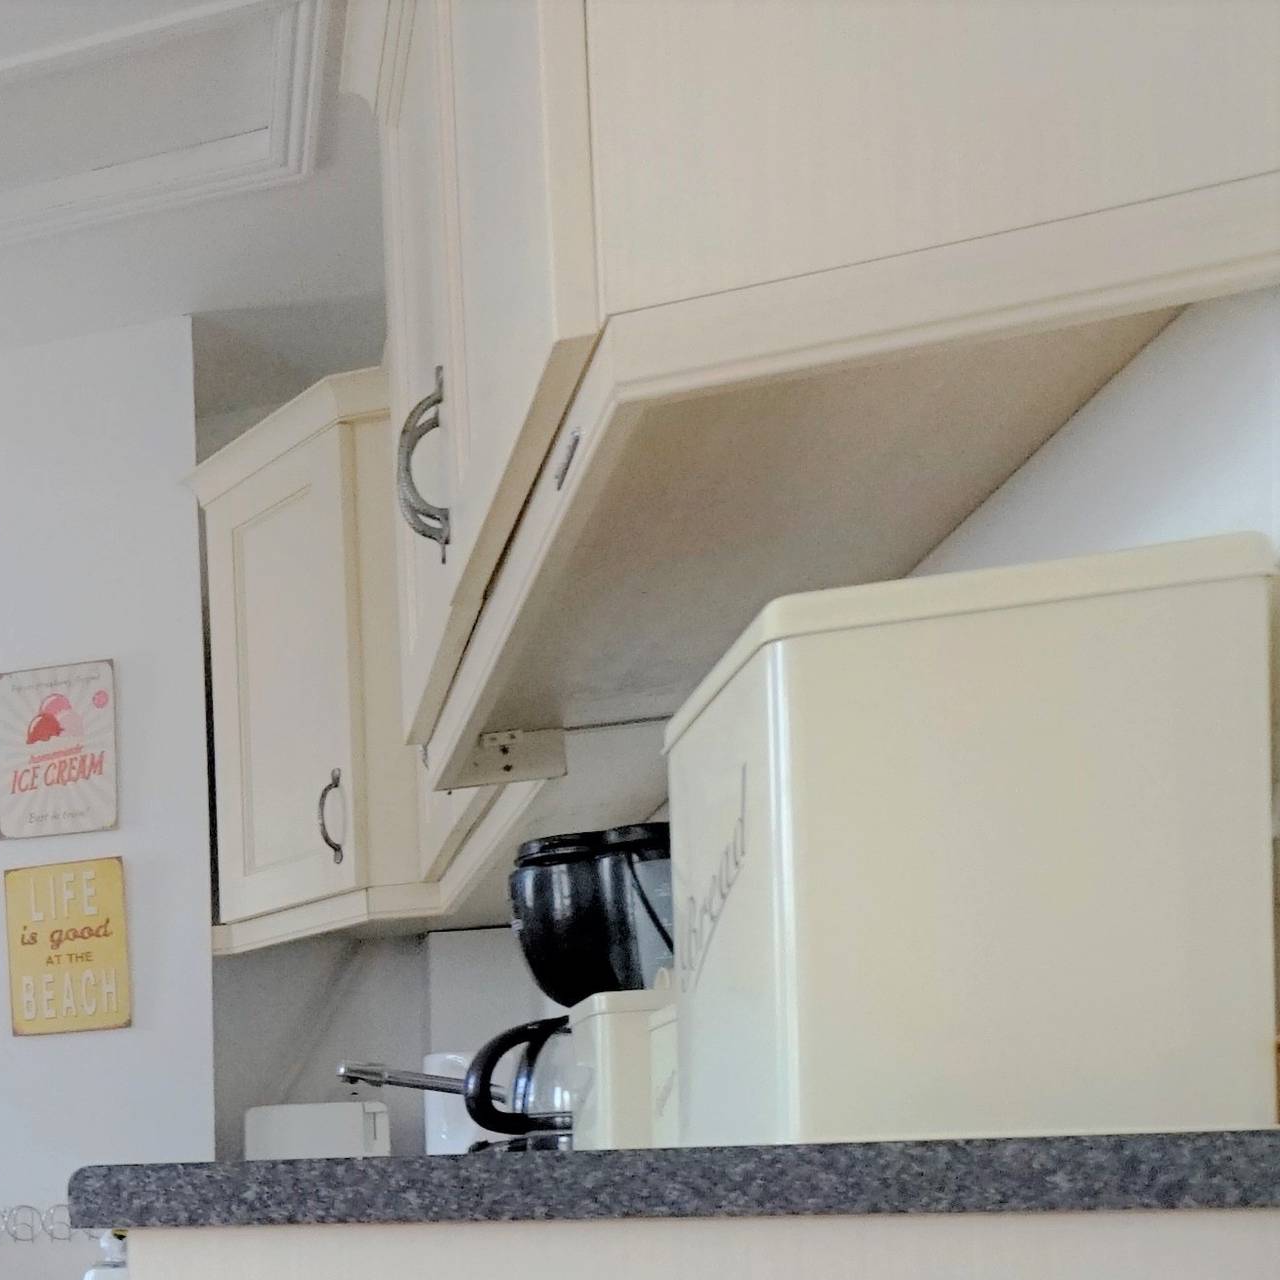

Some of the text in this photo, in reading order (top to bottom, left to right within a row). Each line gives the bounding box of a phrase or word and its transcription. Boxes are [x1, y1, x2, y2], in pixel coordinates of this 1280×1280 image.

[10, 767, 40, 794] ICE
[44, 751, 105, 786] CREAM
[30, 870, 97, 922] LIFE
[20, 918, 113, 950] is good
[46, 952, 93, 967] AT THE
[21, 968, 118, 1021] BEACH
